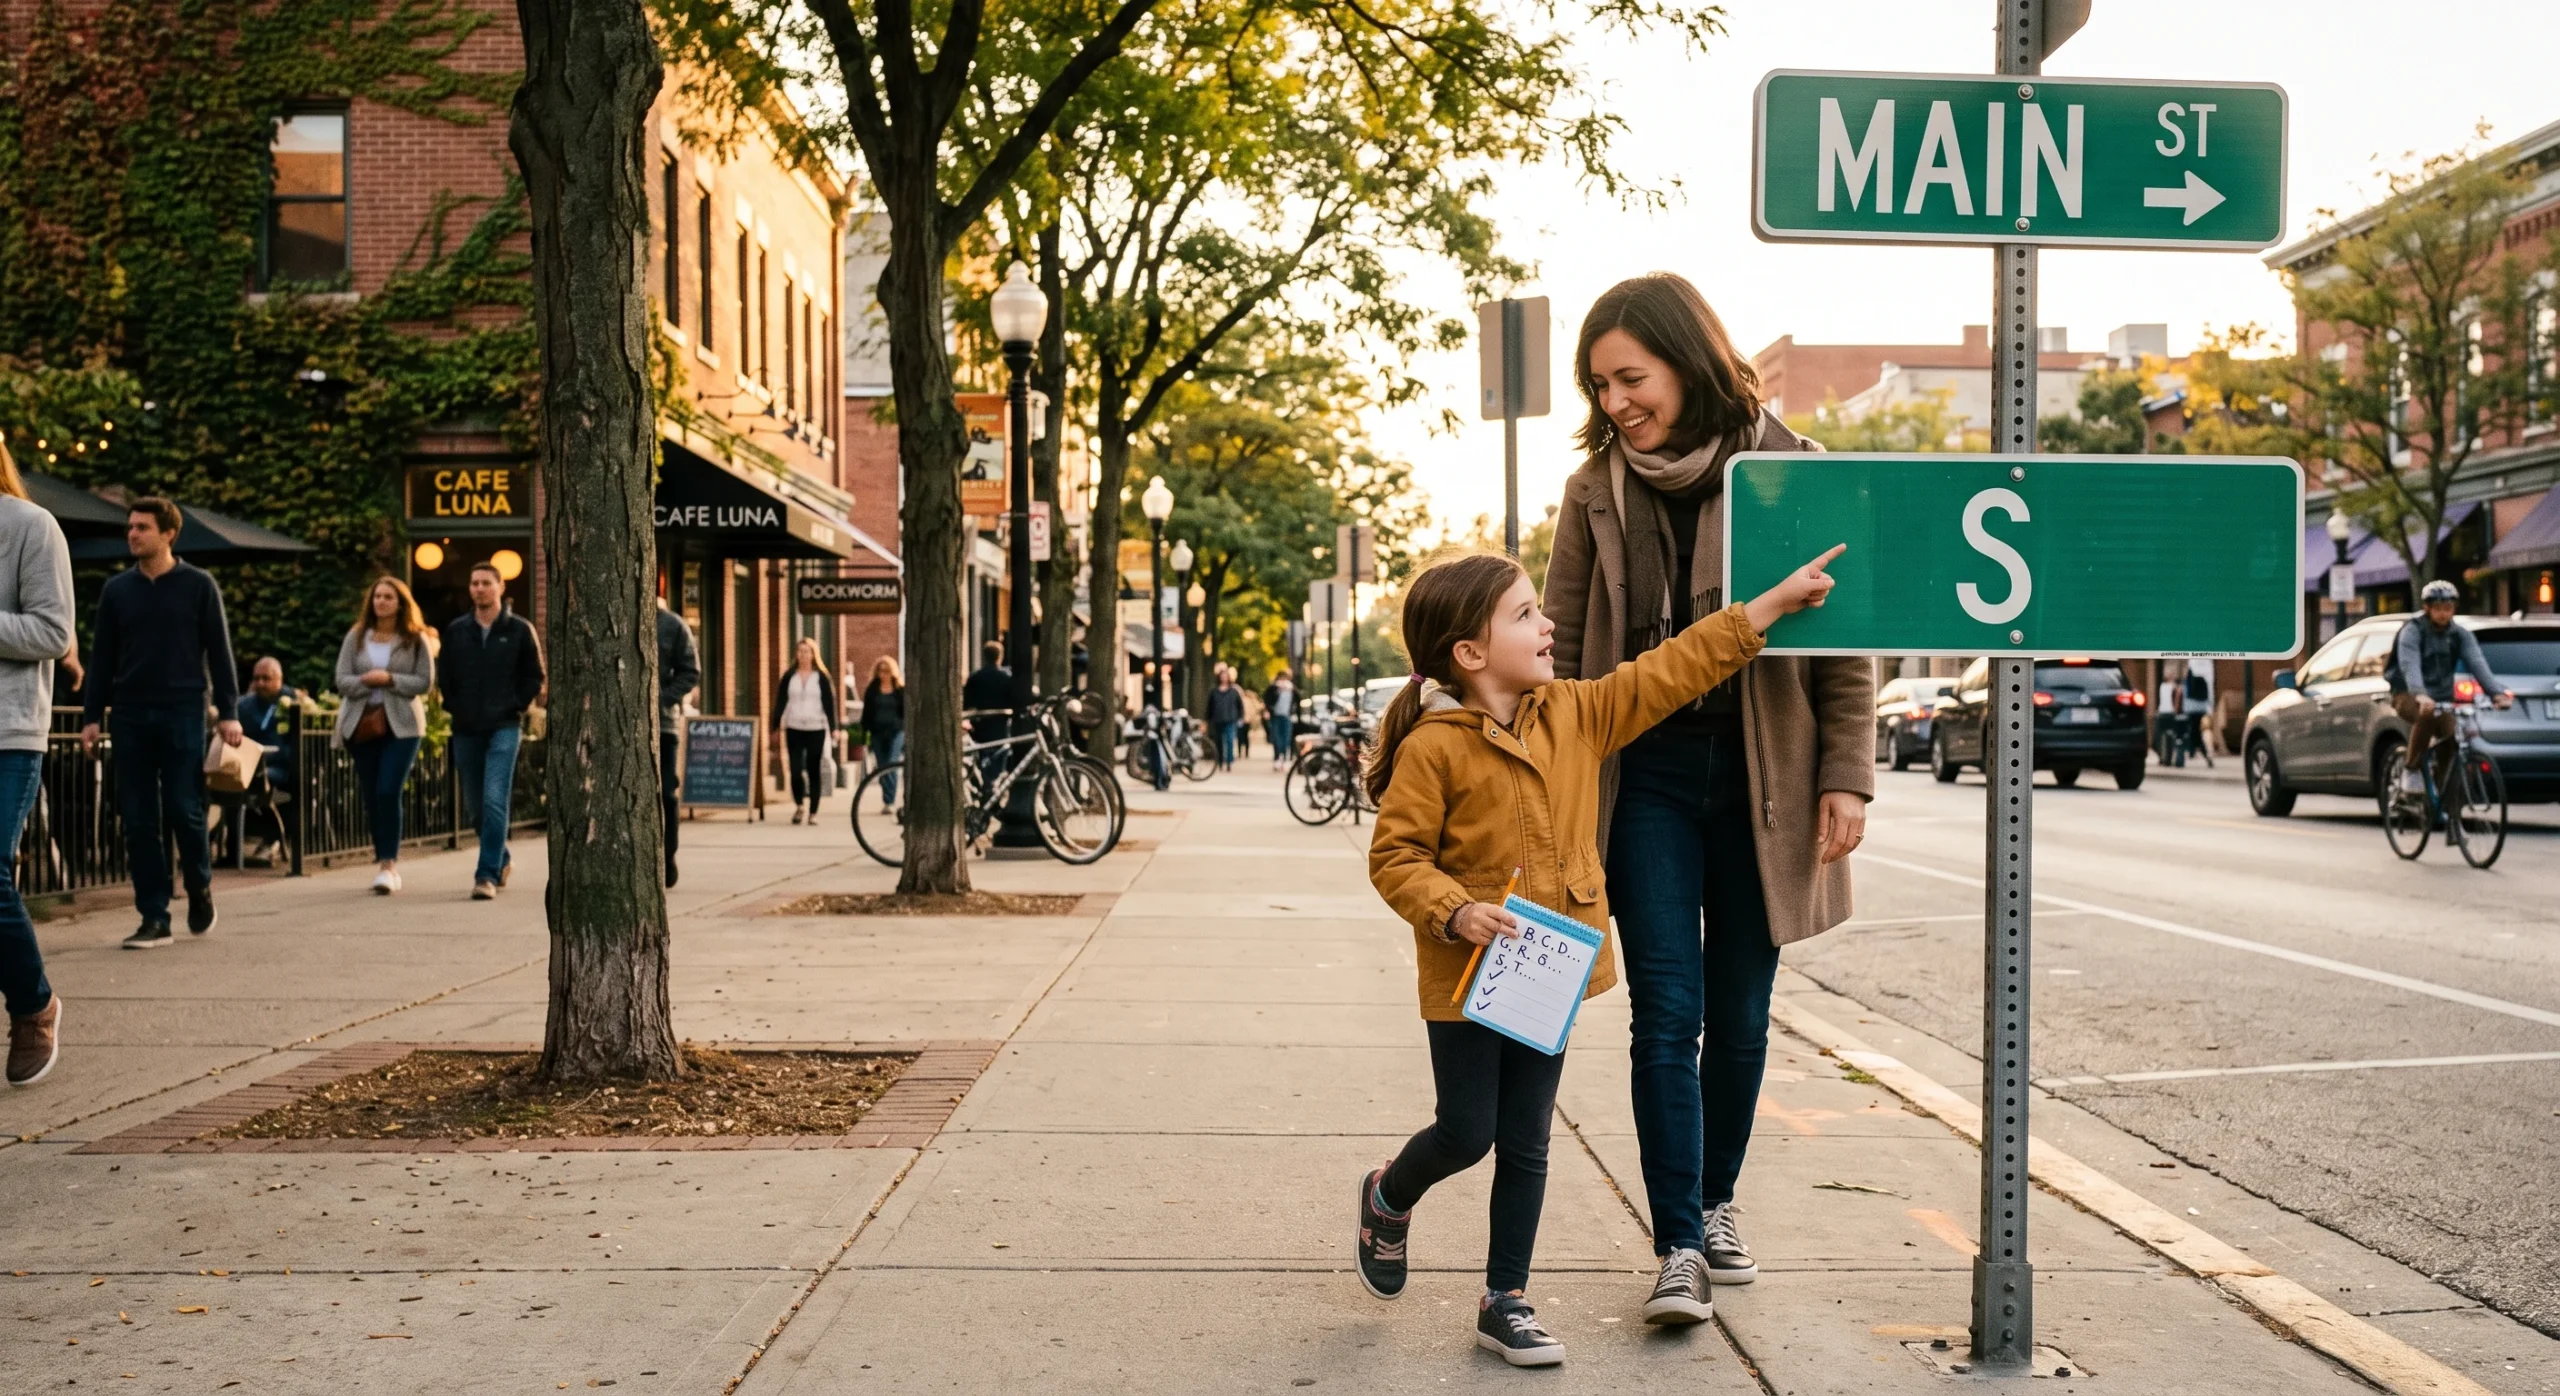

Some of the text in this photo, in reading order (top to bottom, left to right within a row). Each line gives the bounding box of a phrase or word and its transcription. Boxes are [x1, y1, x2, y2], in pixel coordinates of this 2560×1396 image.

[1817, 97, 2217, 219] MAIN ST
[434, 469, 510, 492] CAFE
[435, 493, 512, 515] LUNA
[654, 505, 780, 527] CAFE LUNA
[1956, 487, 2032, 625] S
[801, 584, 898, 600] BOOKWORM
